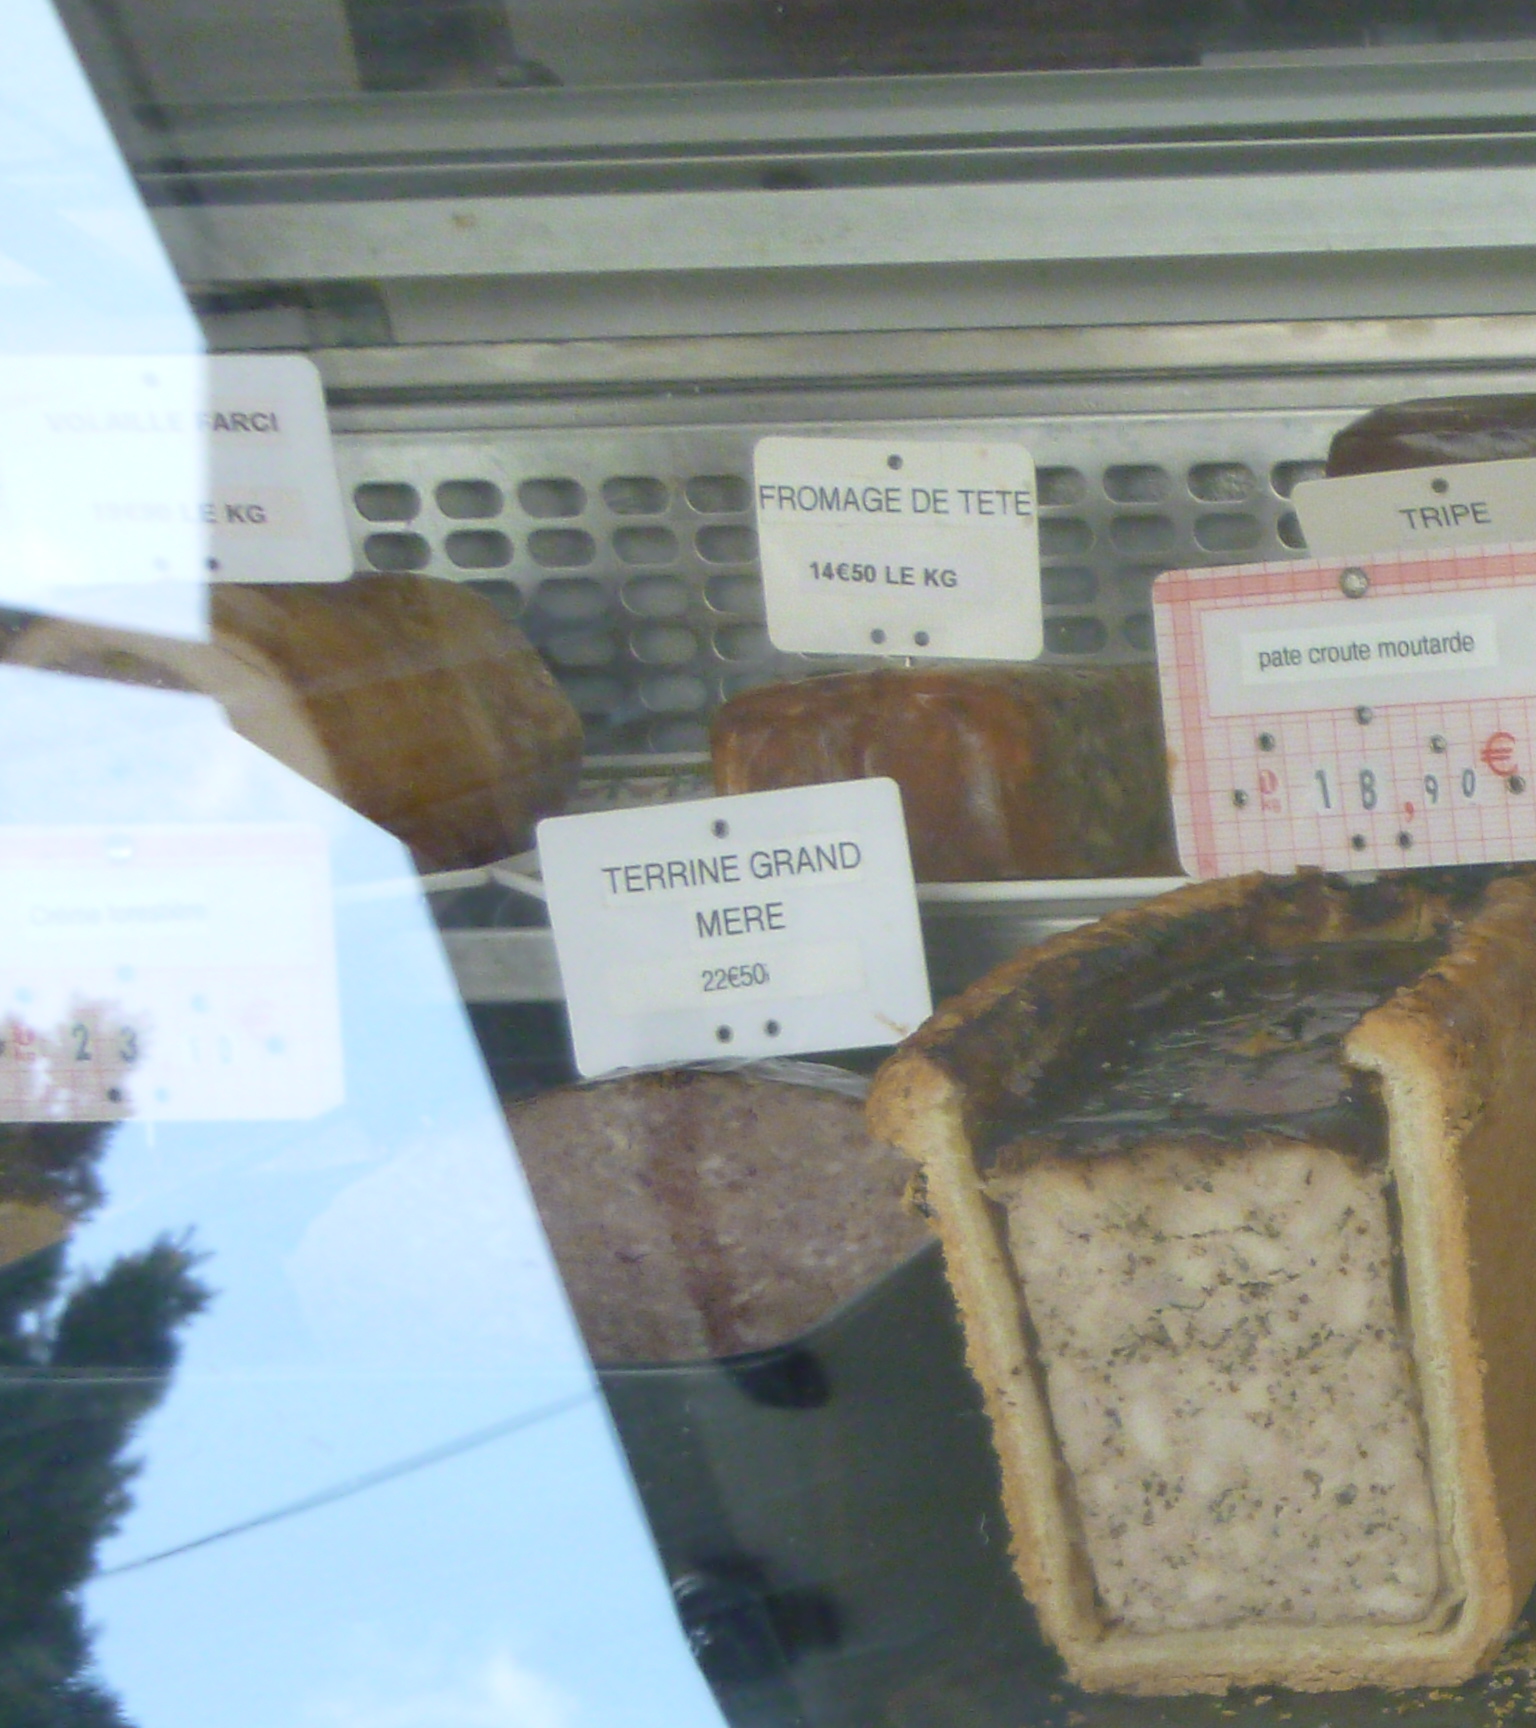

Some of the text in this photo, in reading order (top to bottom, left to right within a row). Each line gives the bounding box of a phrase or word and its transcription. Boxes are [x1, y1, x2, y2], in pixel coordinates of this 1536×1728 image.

[225, 504, 267, 524] KG
[759, 486, 1031, 515] FROMAGE DE TETE
[1400, 502, 1492, 530] TRIPE
[809, 562, 958, 587] 14€50 LE KG
[1259, 630, 1475, 671] pate croute moutarde
[602, 842, 861, 894] TERRINE GRAND
[696, 902, 786, 938] MERE
